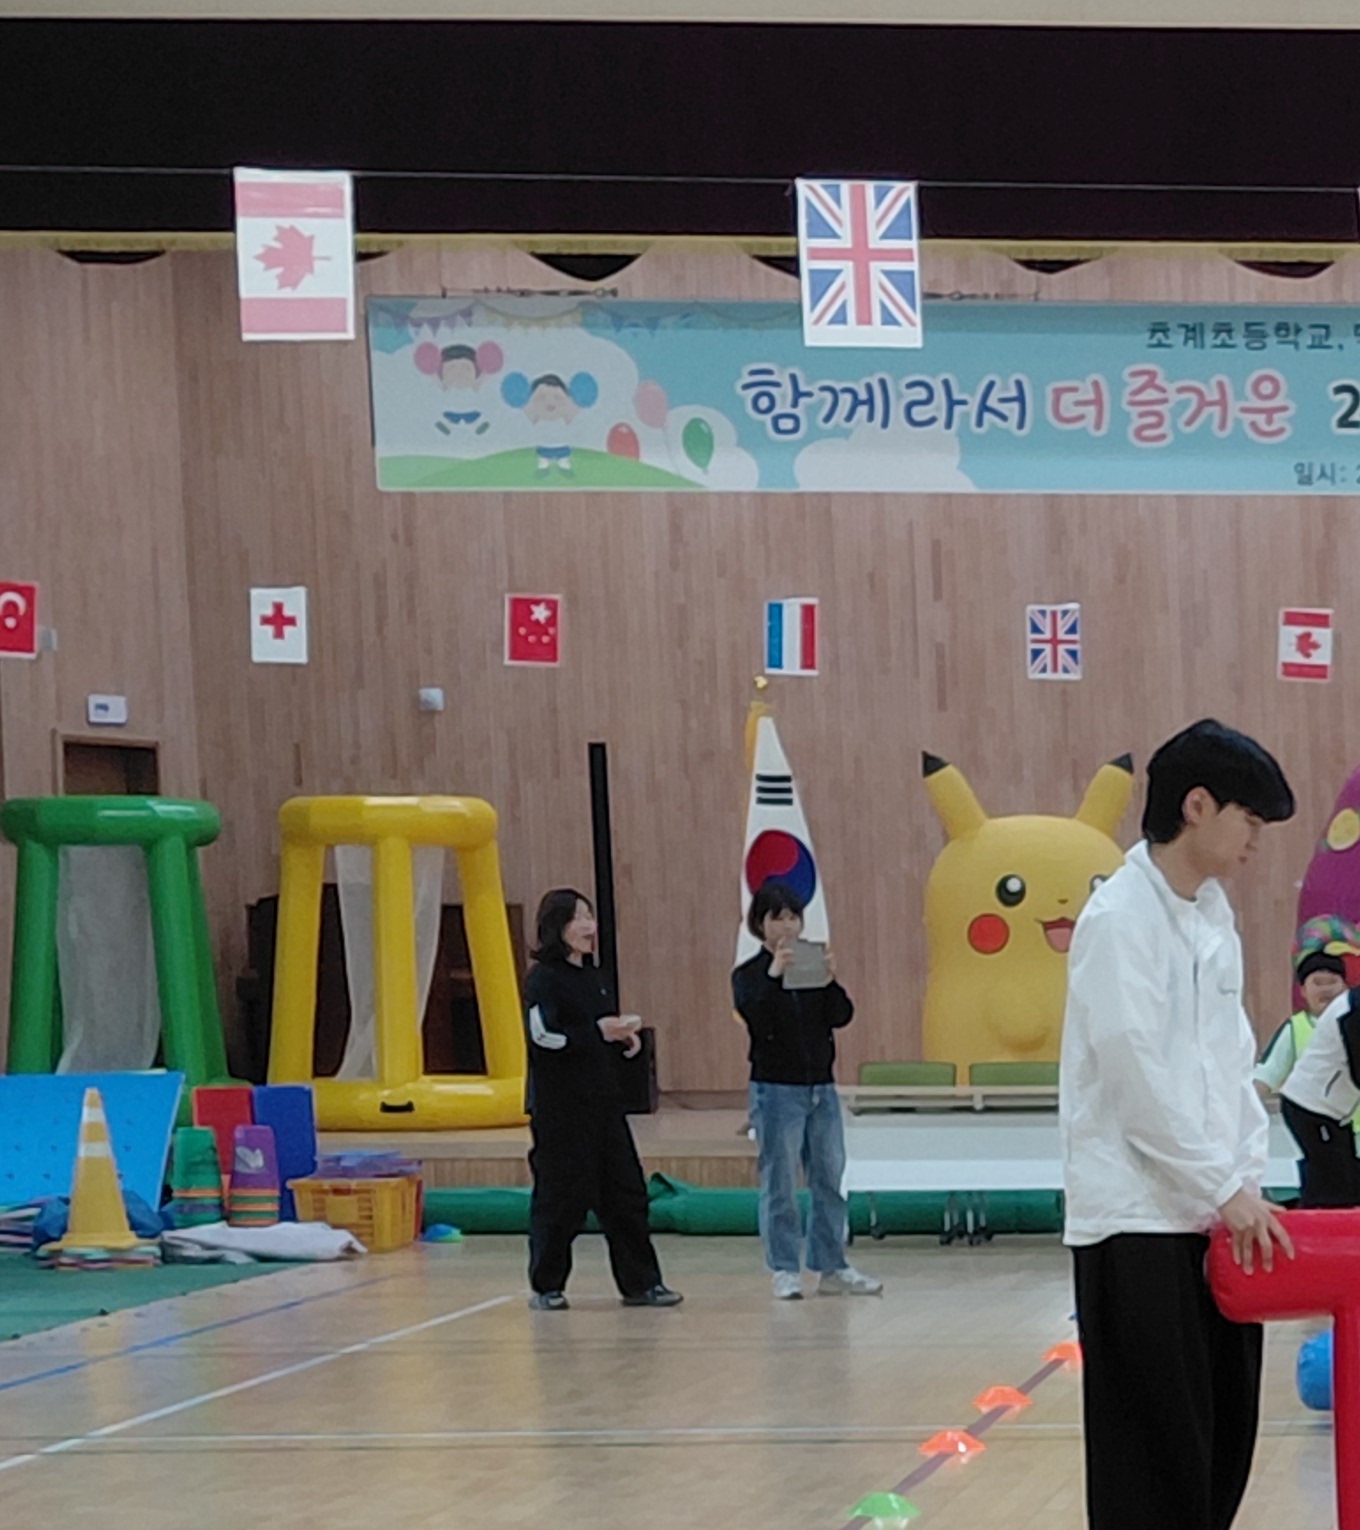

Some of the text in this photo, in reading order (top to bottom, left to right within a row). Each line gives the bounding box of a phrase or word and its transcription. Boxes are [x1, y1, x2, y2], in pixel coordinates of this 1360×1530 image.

[741, 368, 1028, 436] 함께라서
[1051, 380, 1104, 432] 더
[1127, 368, 1290, 443] 즐거운
[1292, 462, 1348, 487] 일시:
